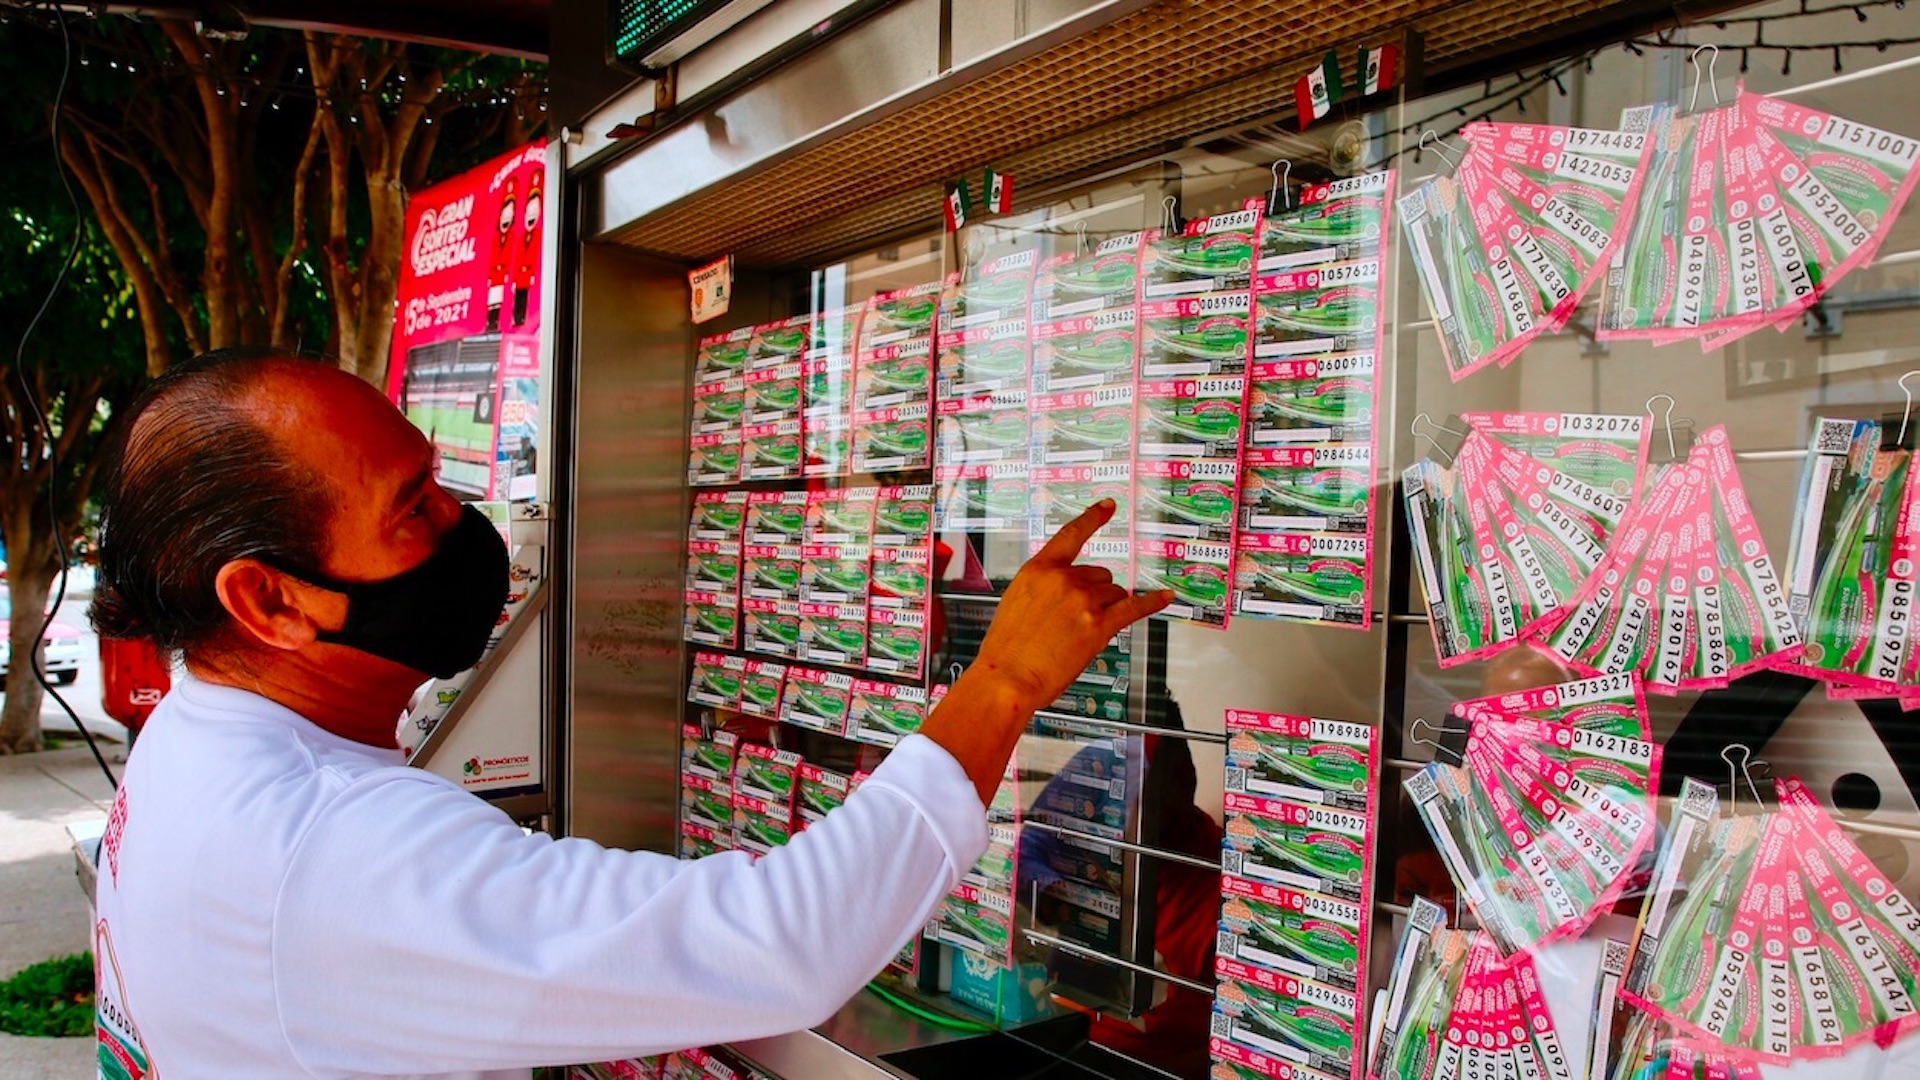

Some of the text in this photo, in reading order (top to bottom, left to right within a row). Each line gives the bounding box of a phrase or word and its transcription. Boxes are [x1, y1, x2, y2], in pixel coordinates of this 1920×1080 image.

[1568, 131, 1643, 150] 1974482
[1826, 119, 1918, 160] 1151001
[1328, 174, 1387, 195] 0583991
[1559, 153, 1632, 184] 1422053
[438, 194, 475, 227] GRAN
[1208, 211, 1258, 230] 1095601
[1545, 199, 1609, 250] 0635083
[1798, 174, 1866, 248] 1952008
[421, 219, 469, 254] SORTEO
[416, 237, 476, 277] ESPECIAL
[1519, 235, 1568, 299] 1774830
[1736, 219, 1760, 310] 0042384
[1766, 210, 1810, 297] 1609016
[1320, 262, 1378, 281] 1057622
[1683, 235, 1706, 325] 0489677
[1199, 295, 1249, 311] 0089902
[1497, 260, 1531, 332] 0116865
[434, 301, 469, 326] 2021
[1317, 354, 1374, 371] 0600913
[1196, 380, 1243, 393] 1451643
[1563, 416, 1641, 432] 1032076
[1191, 462, 1236, 476] 0320574
[1314, 448, 1370, 461] 0984544
[1553, 473, 1623, 517] 0748609
[1311, 538, 1365, 552] 0007295
[1543, 502, 1604, 562] 0801714
[1186, 544, 1229, 560] 1568695
[1514, 537, 1557, 609] 1459857
[1489, 562, 1514, 637] 1416587
[1753, 558, 1798, 646] 0785425
[1561, 586, 1611, 658] 0746651
[1703, 586, 1725, 675] 0785866
[1879, 581, 1911, 679] 0850978
[1663, 598, 1686, 684] 1290167
[1558, 674, 1631, 698] 1573327
[1311, 720, 1370, 740] 1198986
[1574, 731, 1649, 757] 0162183
[1308, 809, 1365, 831] 0020927
[1570, 779, 1641, 832] 0190652
[1557, 811, 1620, 876] 1929394
[1524, 843, 1575, 918] 1816327
[1852, 865, 1869, 878] 248
[1304, 896, 1359, 921] 0032558
[1822, 887, 1839, 898] 248
[1738, 916, 1755, 927] 248
[1766, 924, 1783, 933] 248
[1789, 911, 1806, 920] 248
[1848, 930, 1911, 1014] 1631447
[1300, 984, 1354, 1008] 1829639
[1707, 950, 1745, 1034] 0529465
[1770, 963, 1788, 1053] 1499115
[1803, 949, 1839, 1043] 1658184
[1671, 1066, 1688, 1077] 248
[1709, 1070, 1725, 1079] 248
